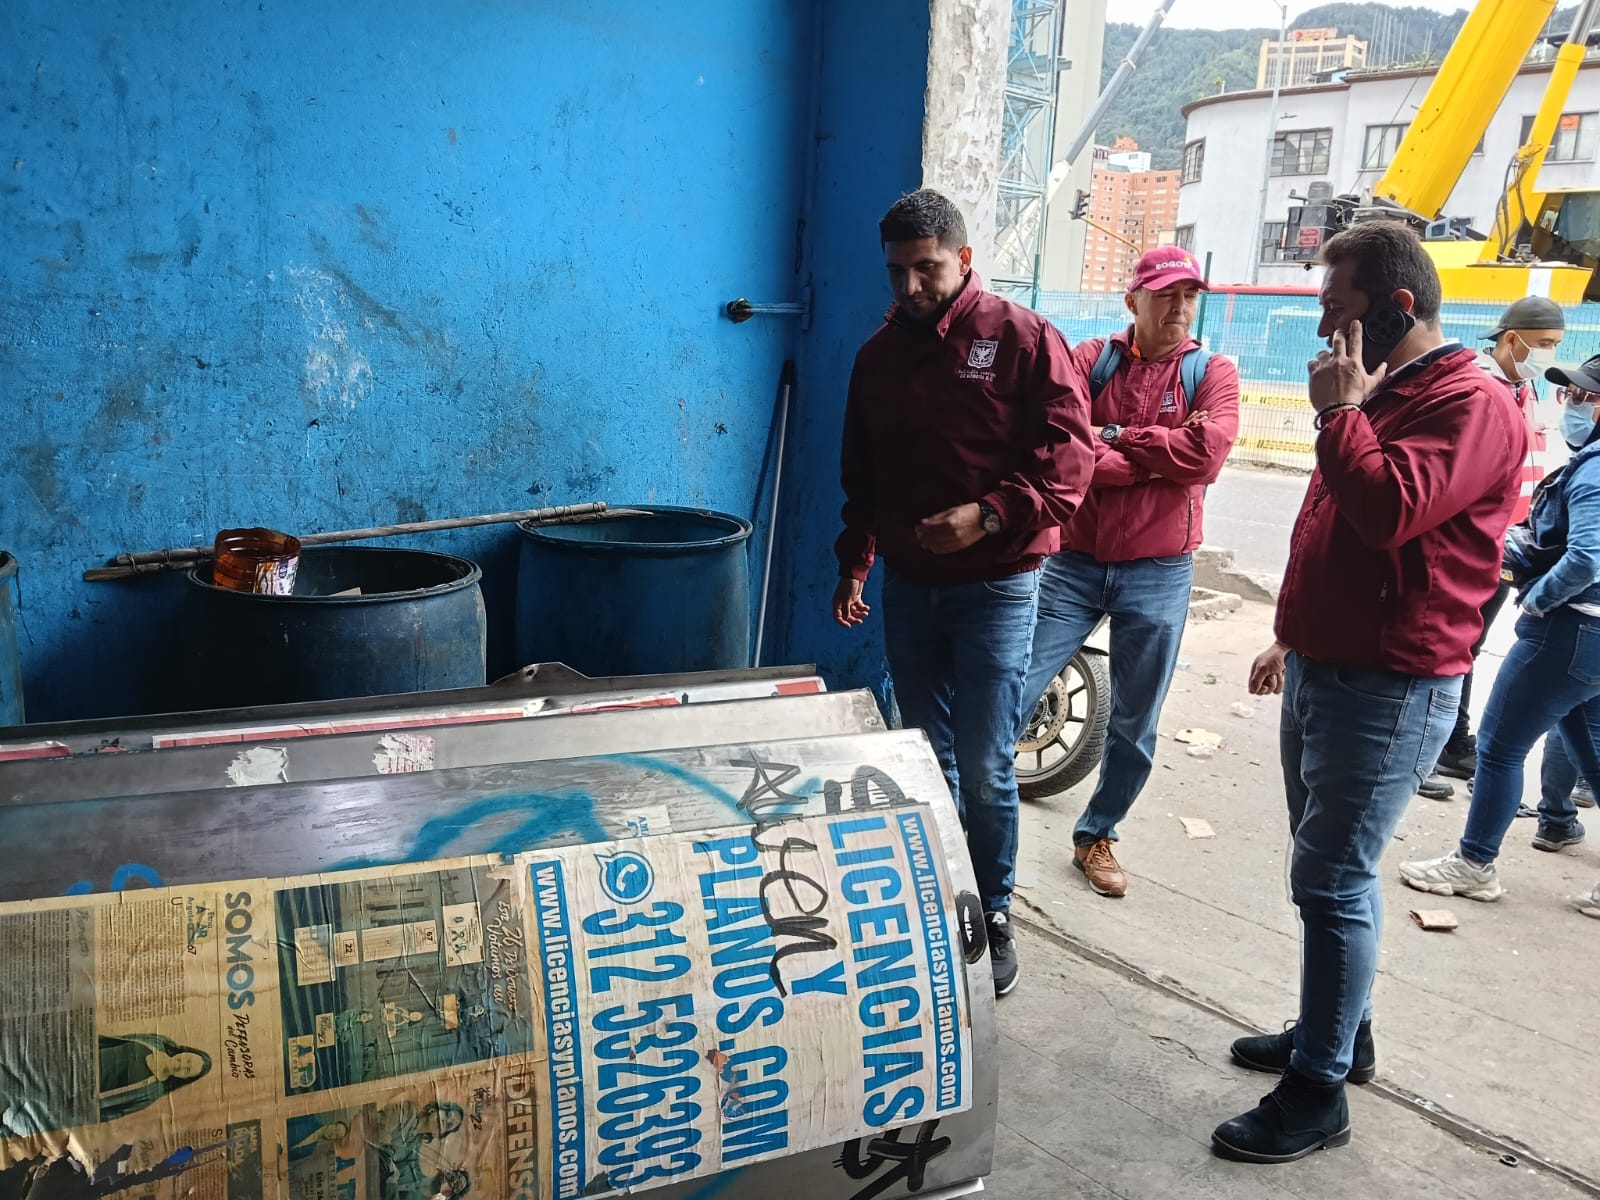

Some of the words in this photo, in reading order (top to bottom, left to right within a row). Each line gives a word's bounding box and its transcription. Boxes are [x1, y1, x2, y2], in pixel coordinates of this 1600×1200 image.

[187, 944, 197, 956] 67
[224, 892, 255, 1010] SOMOS
[345, 943, 353, 954] 22
[486, 918, 504, 979] Votamos
[502, 926, 522, 946] 26
[582, 901, 692, 995] 312
[828, 816, 925, 1127] LICENCIAS
[902, 815, 957, 1108] www.licenciasyplanos.com
[693, 835, 789, 1165] PLANOS.COM
[791, 960, 848, 996] Y
[224, 1039, 242, 1080] Cambio
[232, 1013, 256, 1080] DEFENSORAS
[536, 865, 584, 1200] www.licenciasyplanos.com
[592, 993, 703, 1191] 5326393
